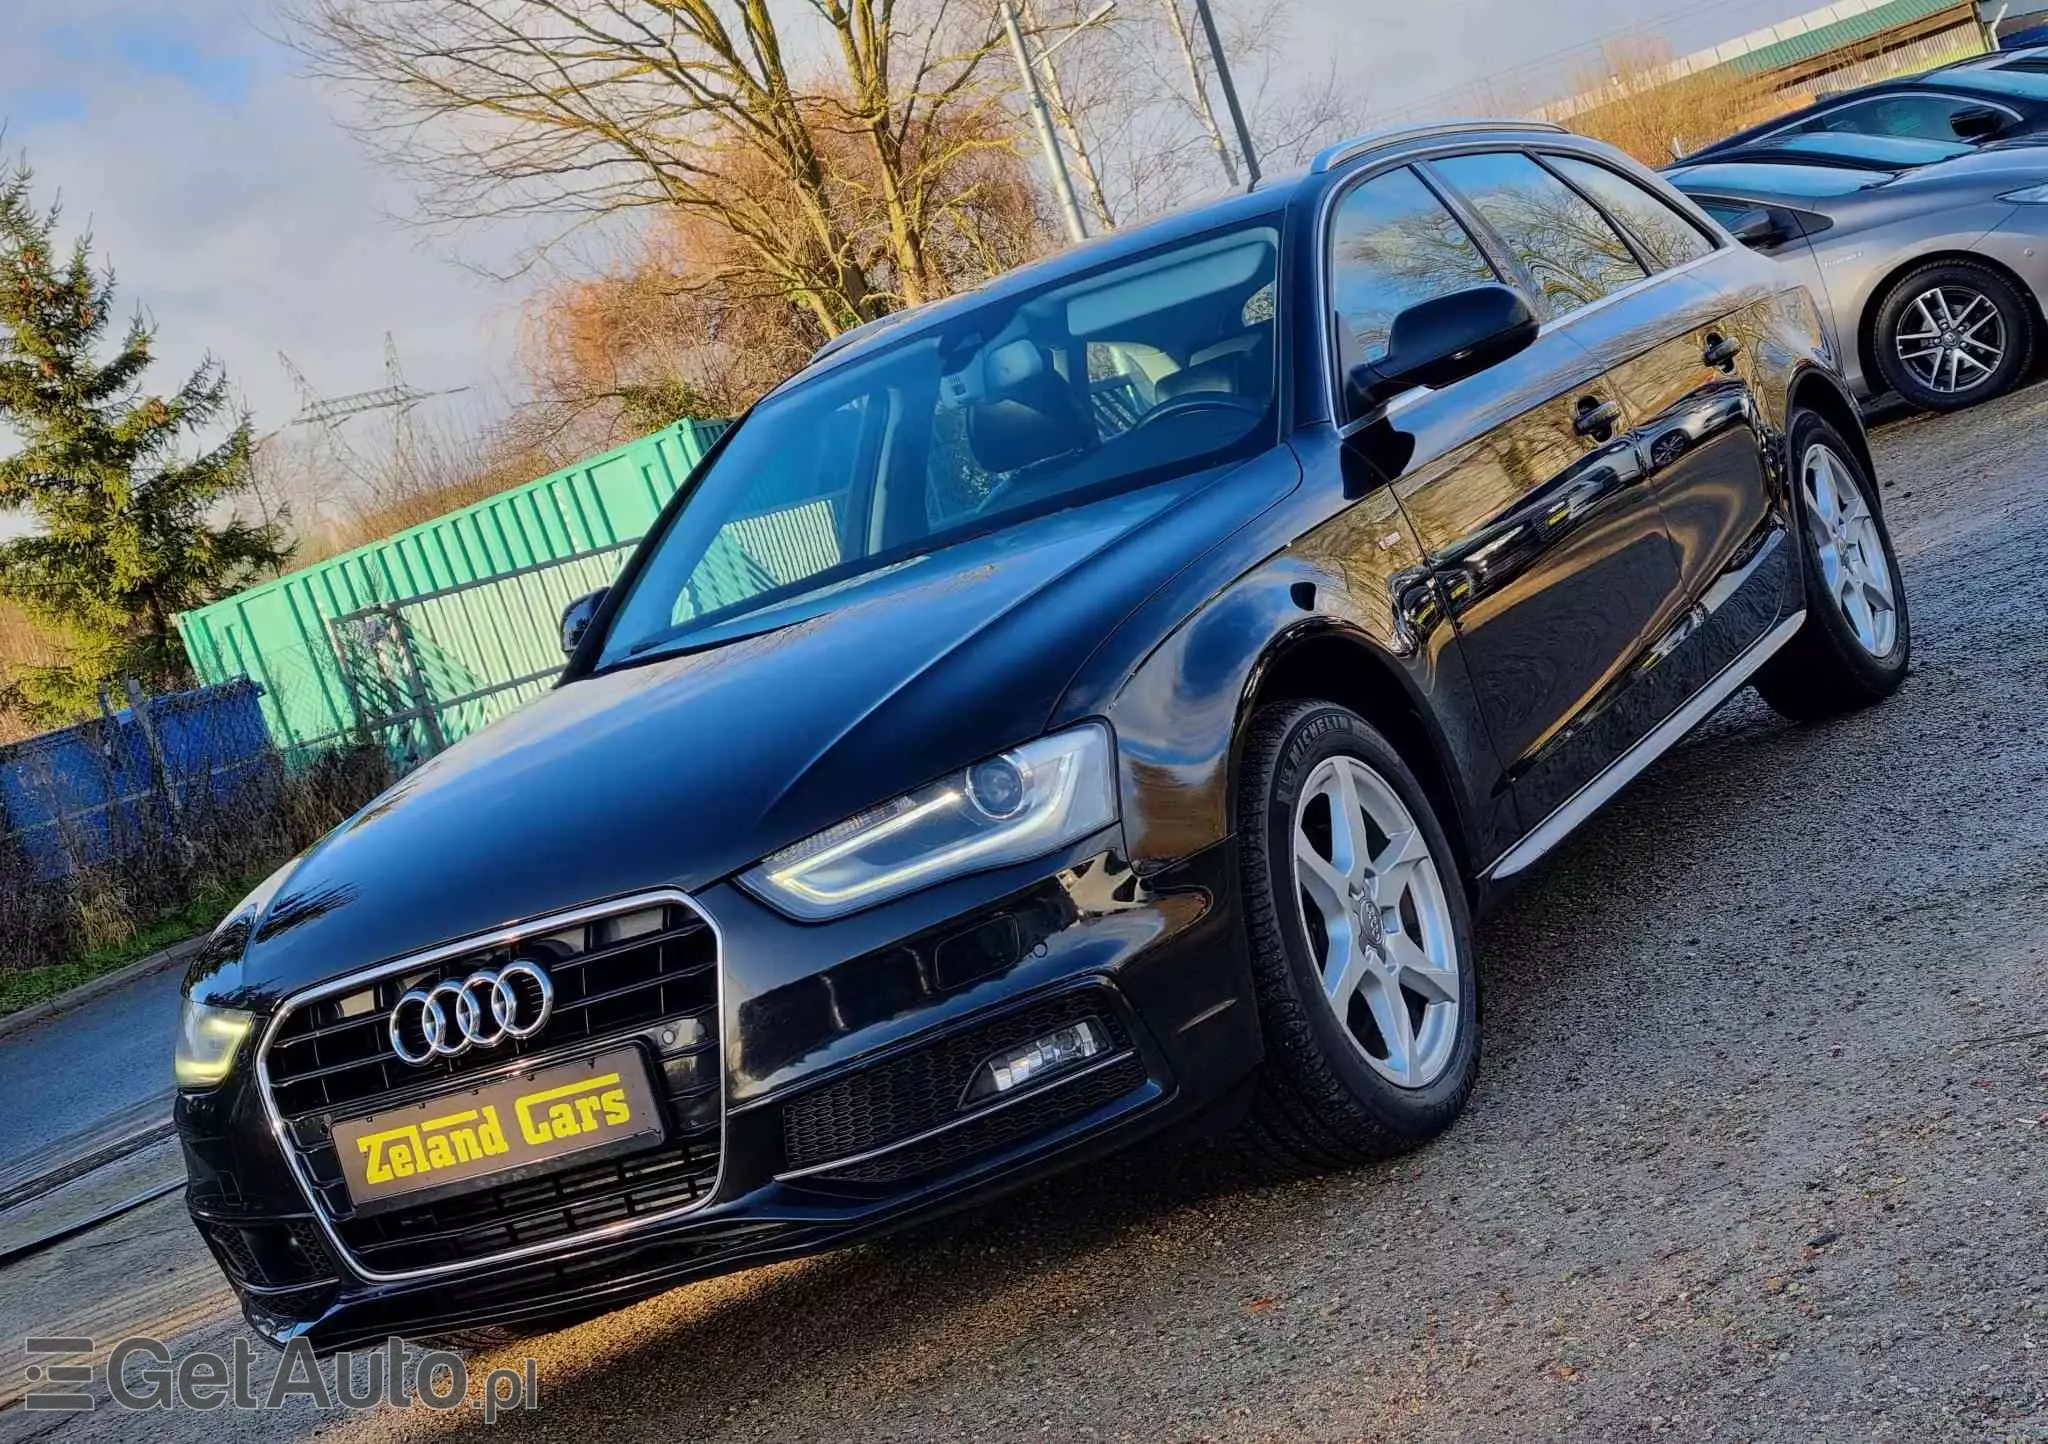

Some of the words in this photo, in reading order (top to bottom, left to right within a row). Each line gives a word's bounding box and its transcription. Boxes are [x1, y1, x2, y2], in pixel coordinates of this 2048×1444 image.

[1289, 715, 1349, 768] MICHELIN
[357, 1105, 509, 1184] Zeland
[515, 1072, 631, 1145] Cars
